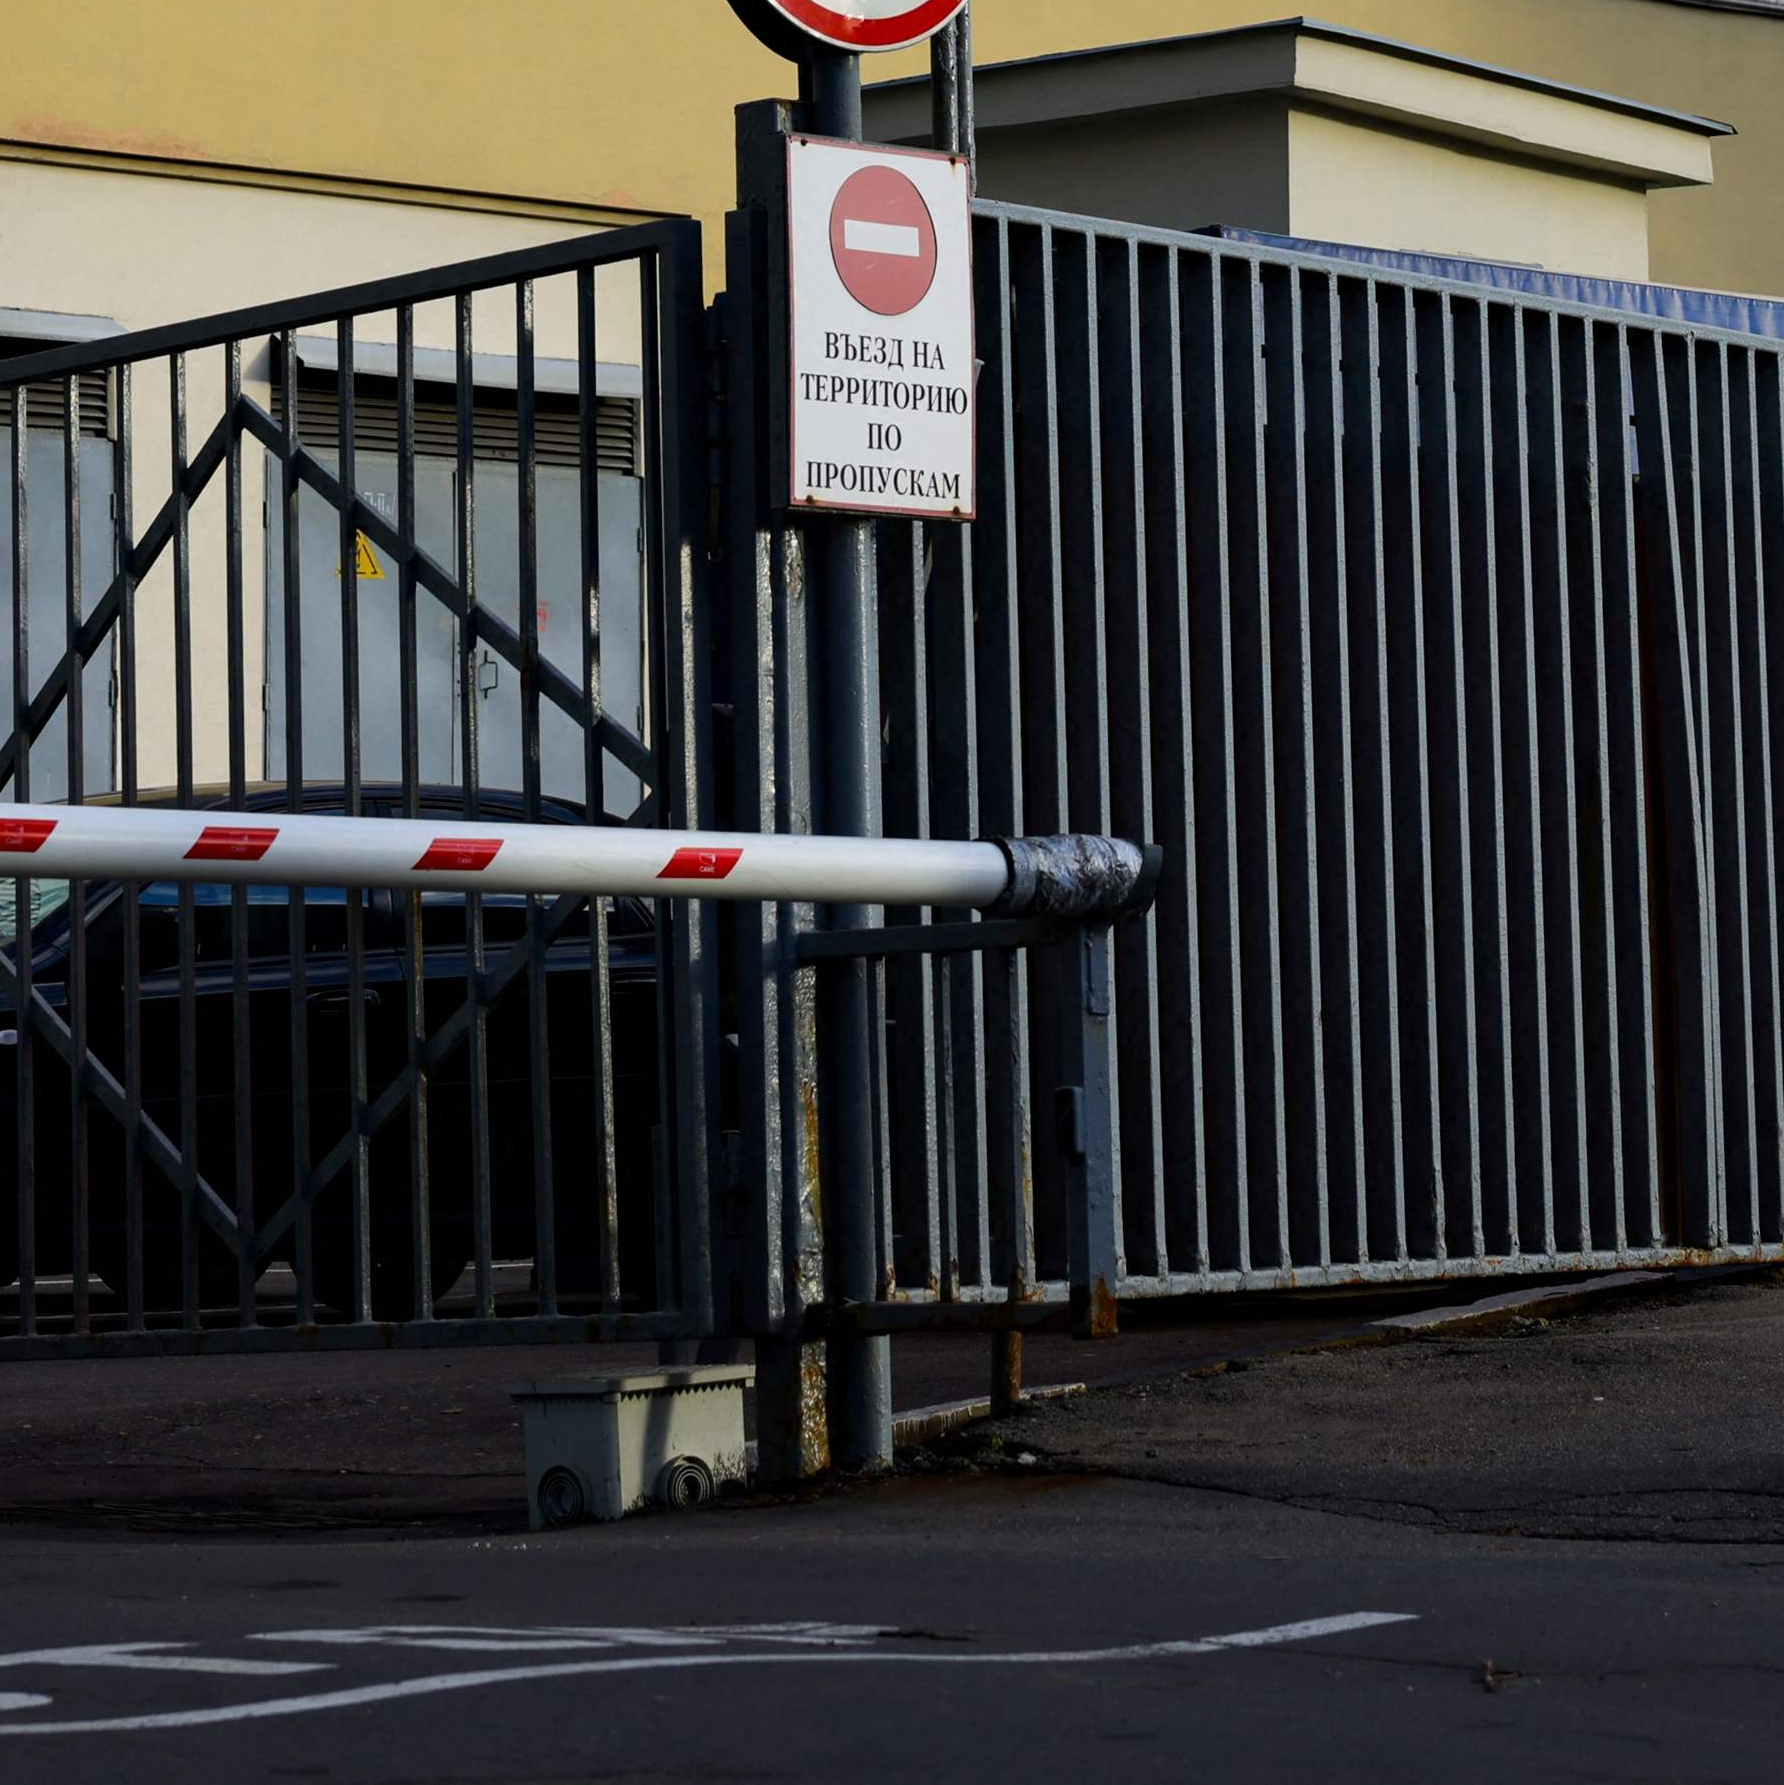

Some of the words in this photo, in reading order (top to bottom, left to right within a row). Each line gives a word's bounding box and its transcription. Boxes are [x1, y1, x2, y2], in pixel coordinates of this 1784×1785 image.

[824, 331, 904, 371] ВЪЕЗД
[912, 340, 946, 371] НА
[800, 372, 968, 415] ТЕРРИТОРИЮ
[867, 423, 902, 452] ПО
[806, 461, 961, 500] ПРОПУСКАМ
